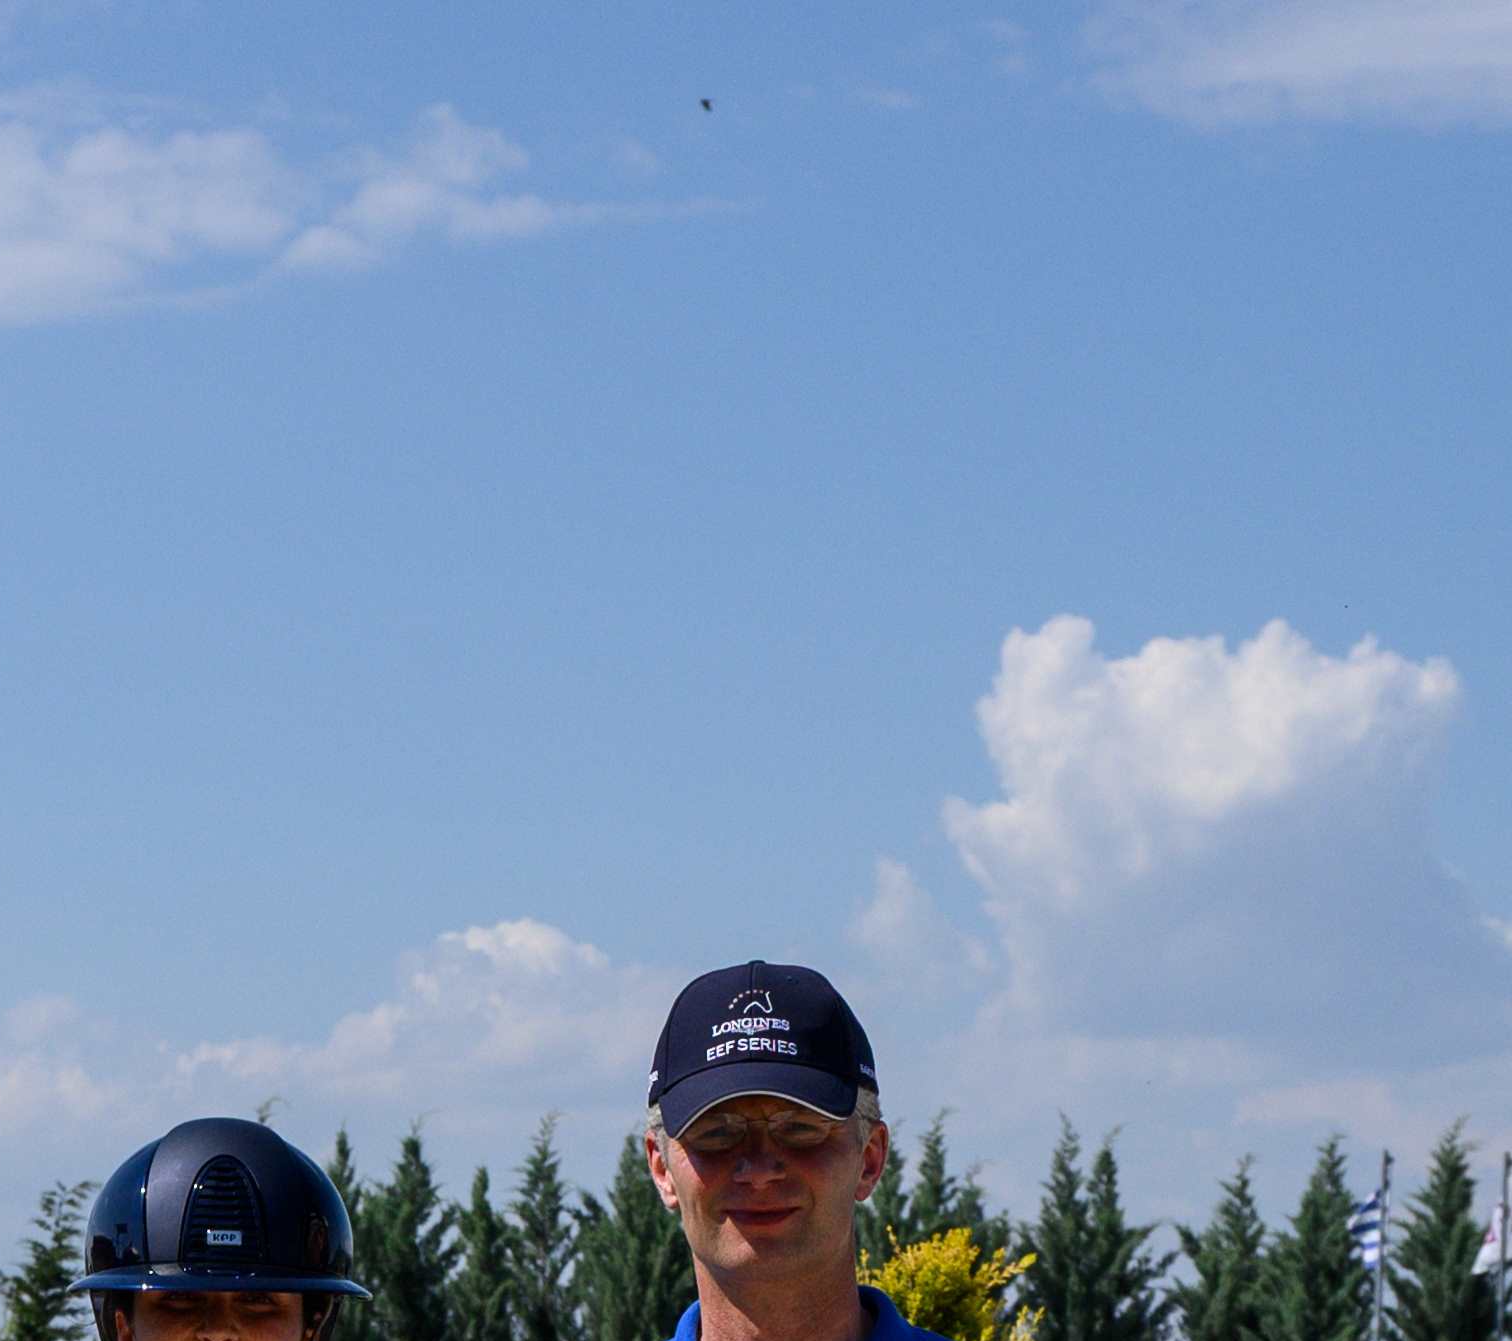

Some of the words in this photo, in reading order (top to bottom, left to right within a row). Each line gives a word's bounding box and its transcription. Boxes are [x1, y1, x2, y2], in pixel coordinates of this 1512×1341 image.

[711, 1017, 790, 1037] LONGINES
[706, 1041, 735, 1061] EEF
[737, 1038, 797, 1055] SERIES
